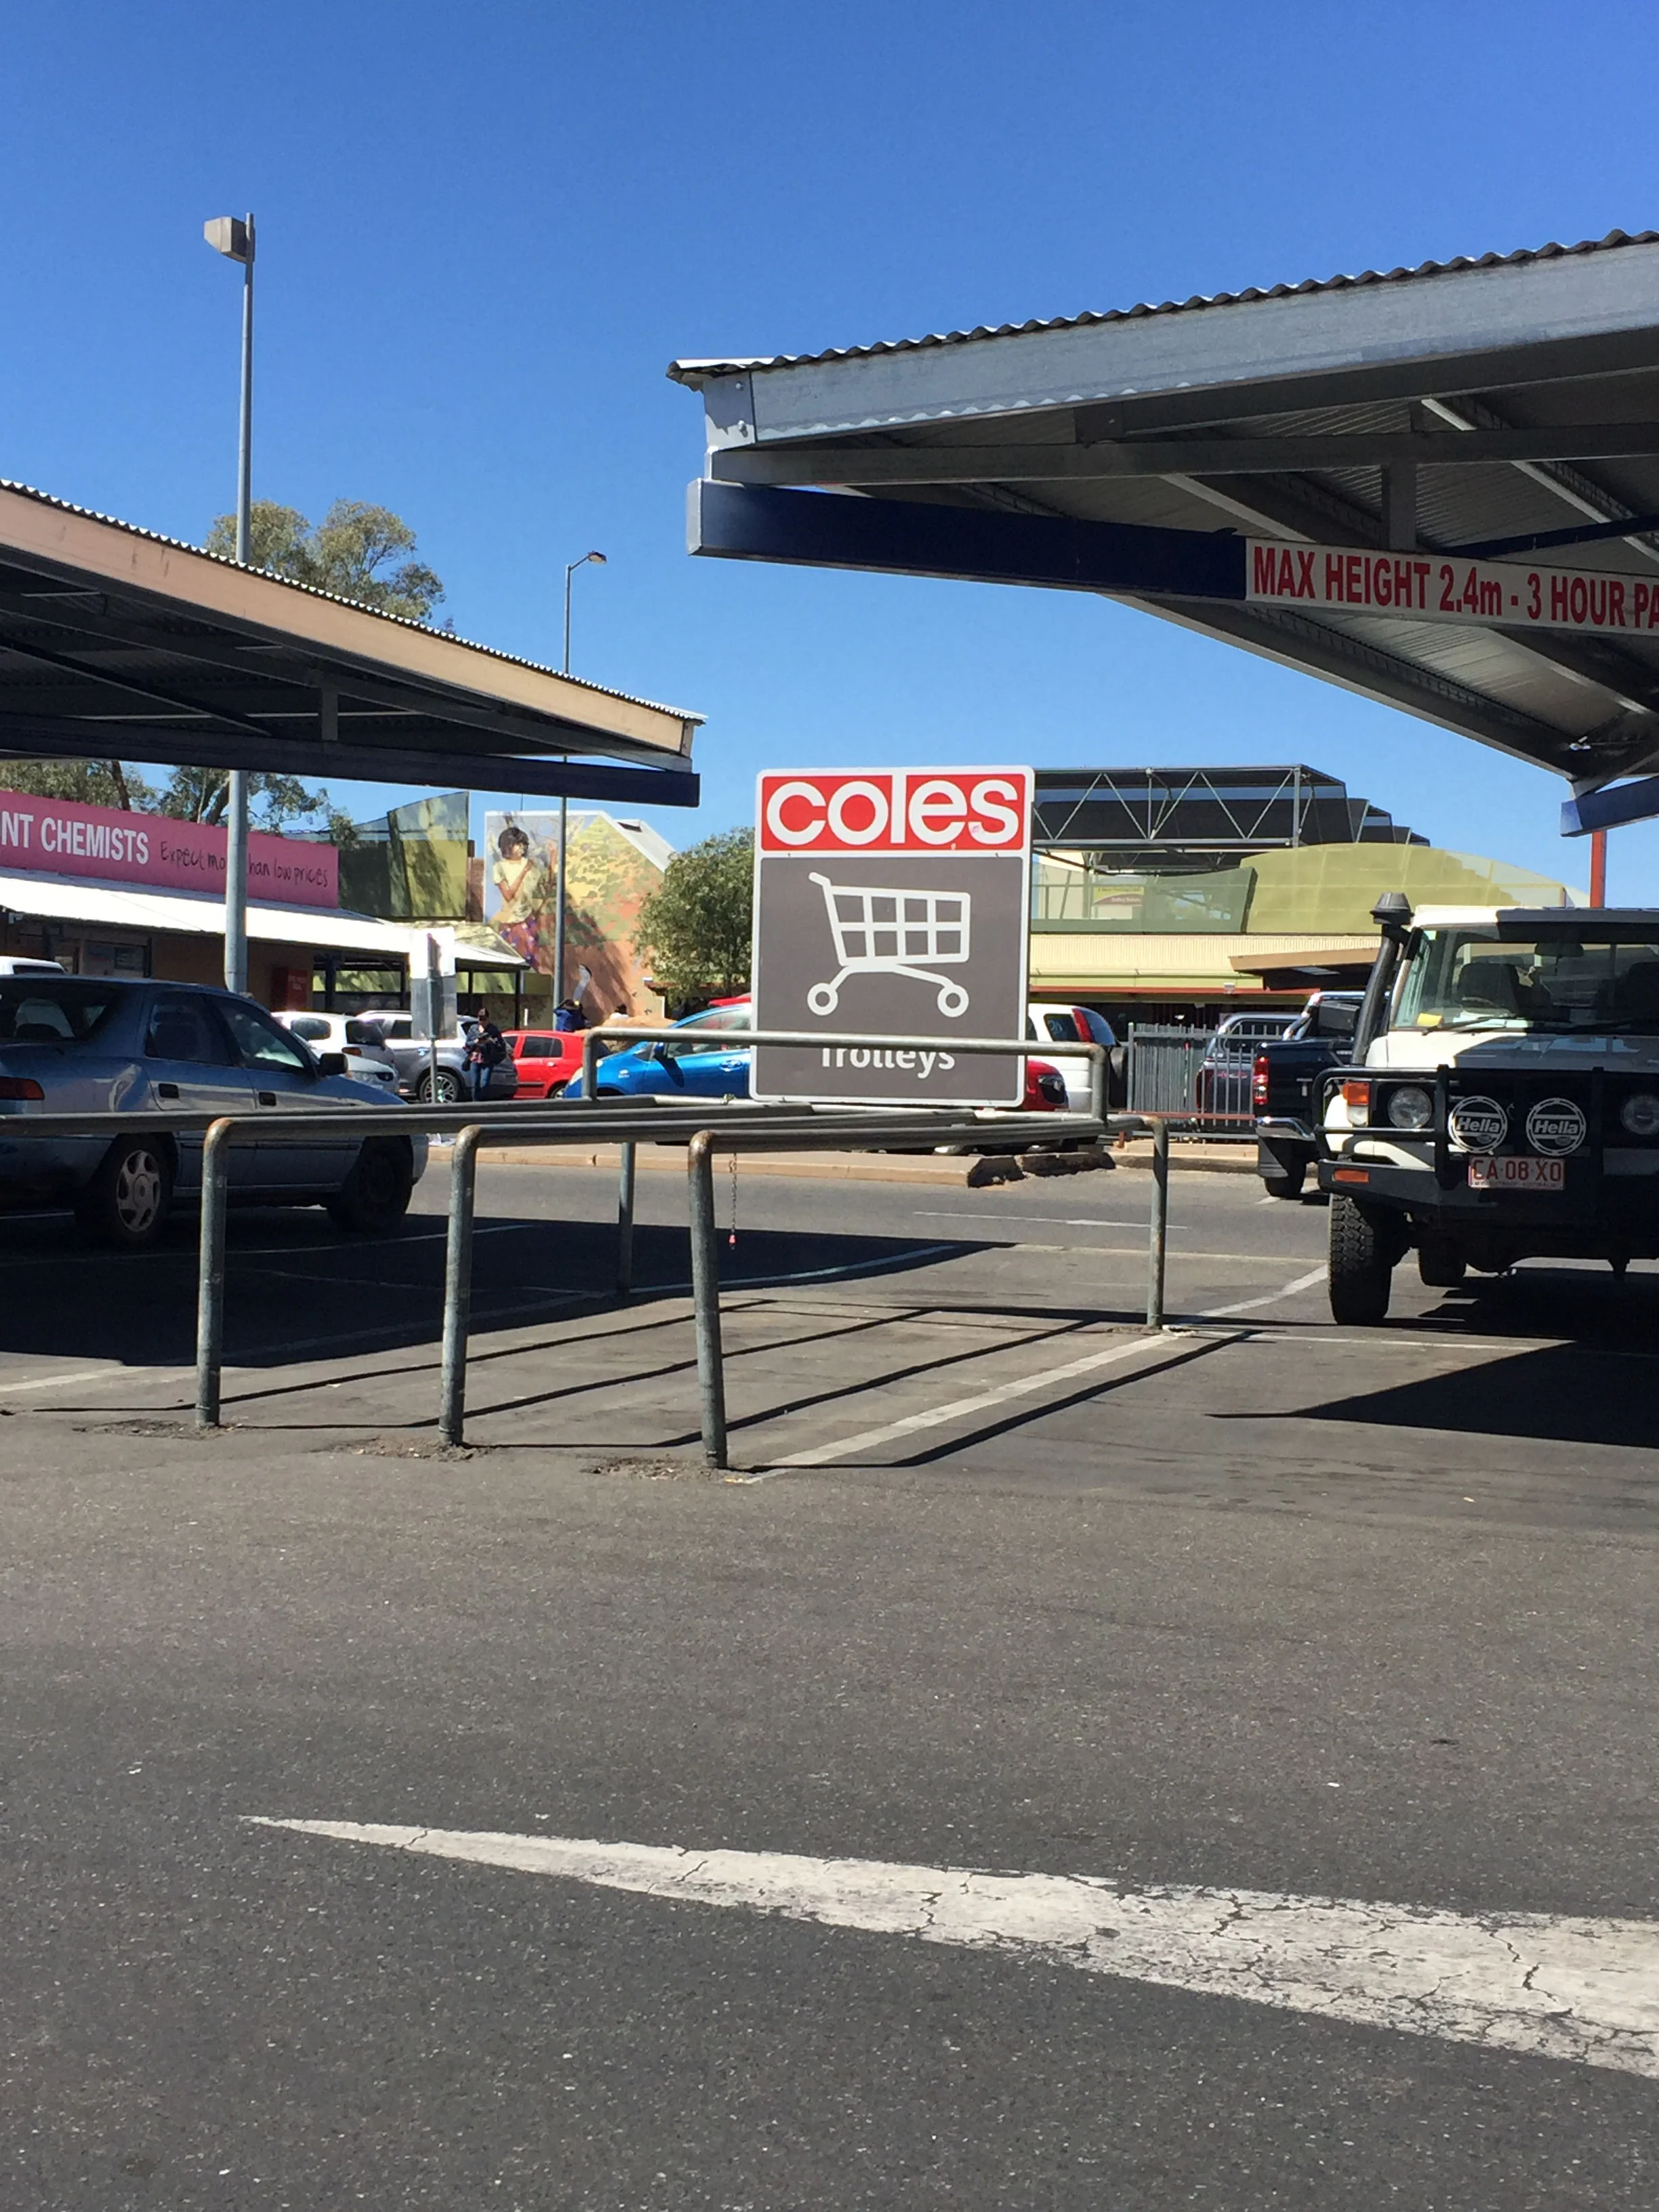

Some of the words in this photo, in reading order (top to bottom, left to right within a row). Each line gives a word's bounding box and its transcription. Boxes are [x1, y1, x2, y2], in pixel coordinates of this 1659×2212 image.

[1254, 546, 1315, 599] MAX
[1326, 554, 1431, 609] HEIGHT
[1439, 565, 1502, 616] 2.4m
[1528, 573, 1541, 620] 3
[1551, 576, 1626, 627] HOUR
[766, 775, 1019, 845] coles
[41, 817, 149, 865] CHEMISTS
[161, 841, 205, 871] Expect
[208, 855, 226, 869] mo
[249, 853, 270, 877] han
[274, 858, 291, 880] low
[294, 863, 329, 888] prices
[1456, 1116, 1500, 1132] Hella
[1534, 1120, 1578, 1134] Hella
